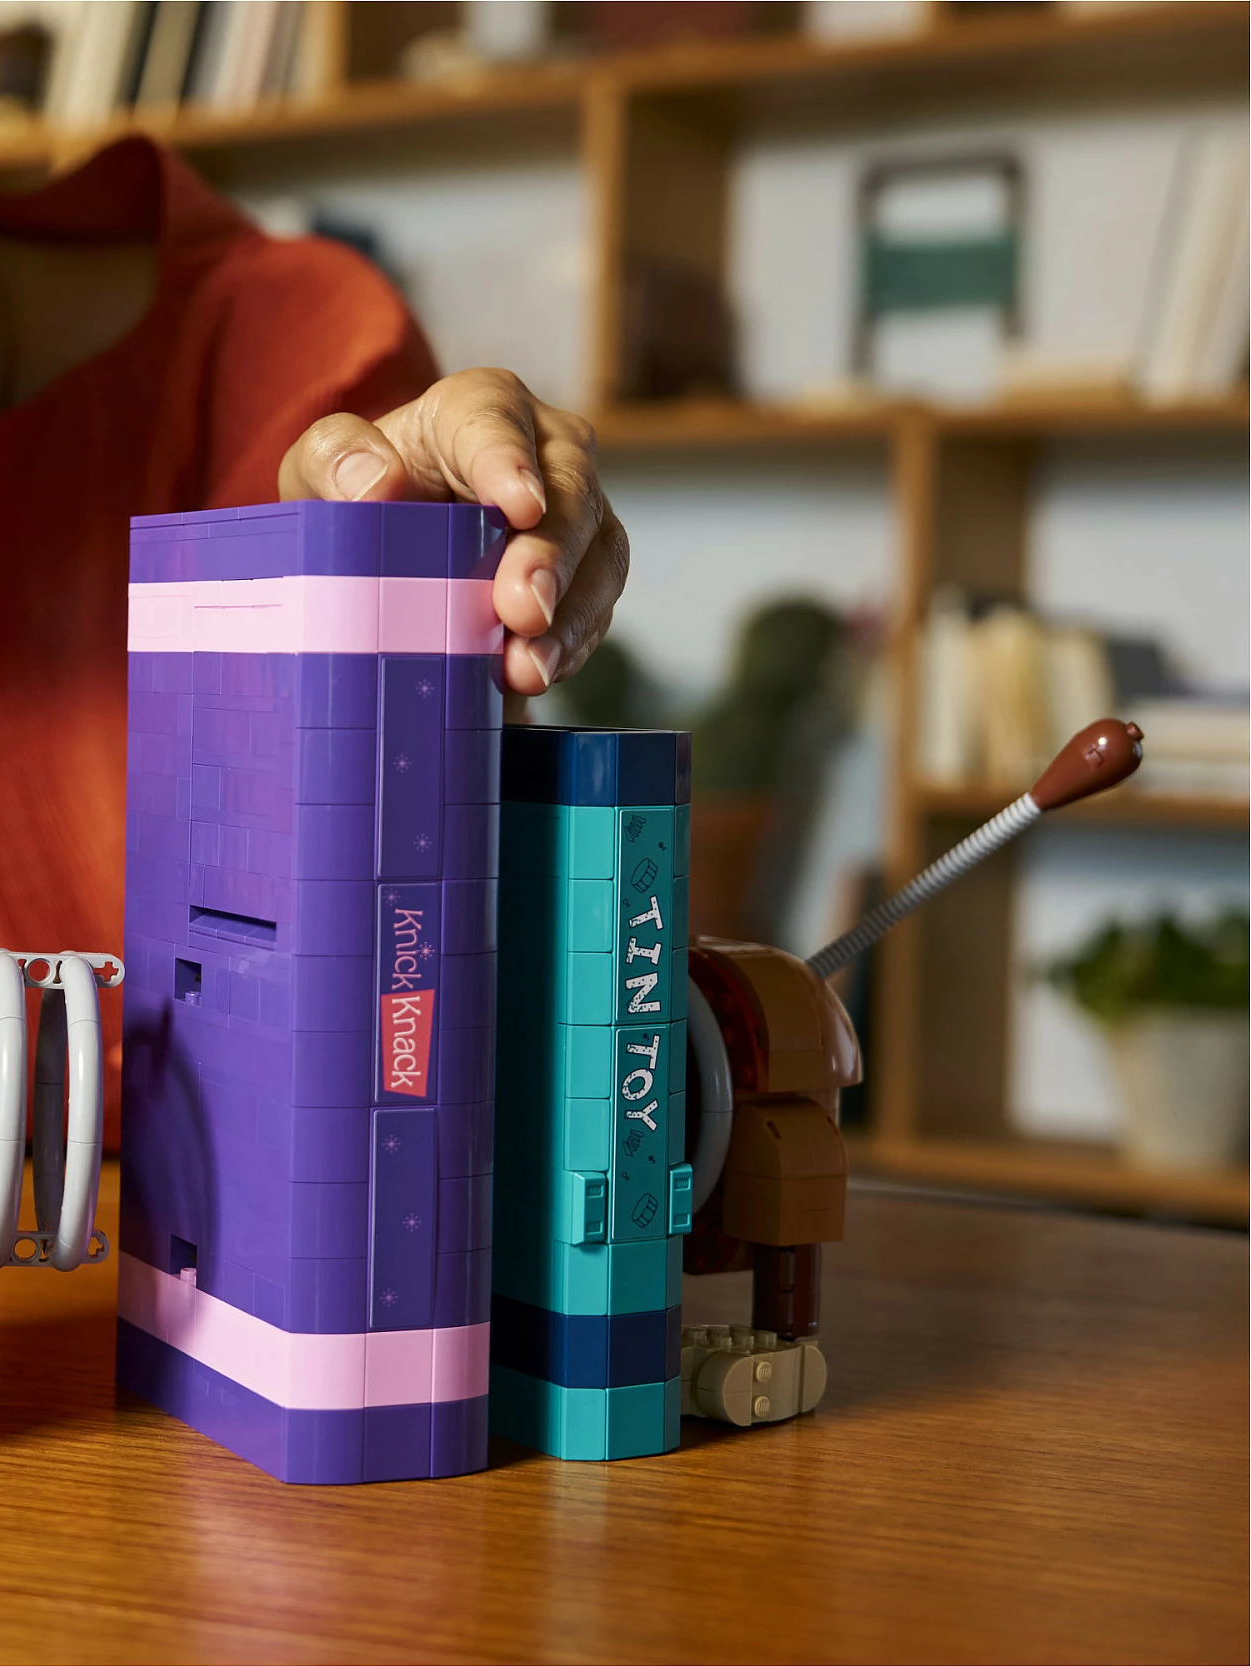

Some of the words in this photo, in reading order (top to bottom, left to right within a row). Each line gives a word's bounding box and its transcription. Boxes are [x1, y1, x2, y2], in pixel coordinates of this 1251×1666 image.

[391, 908, 434, 990] Knick
[625, 895, 664, 1013] TIN
[390, 995, 422, 1088] Knack
[621, 1034, 661, 1132] TOY
